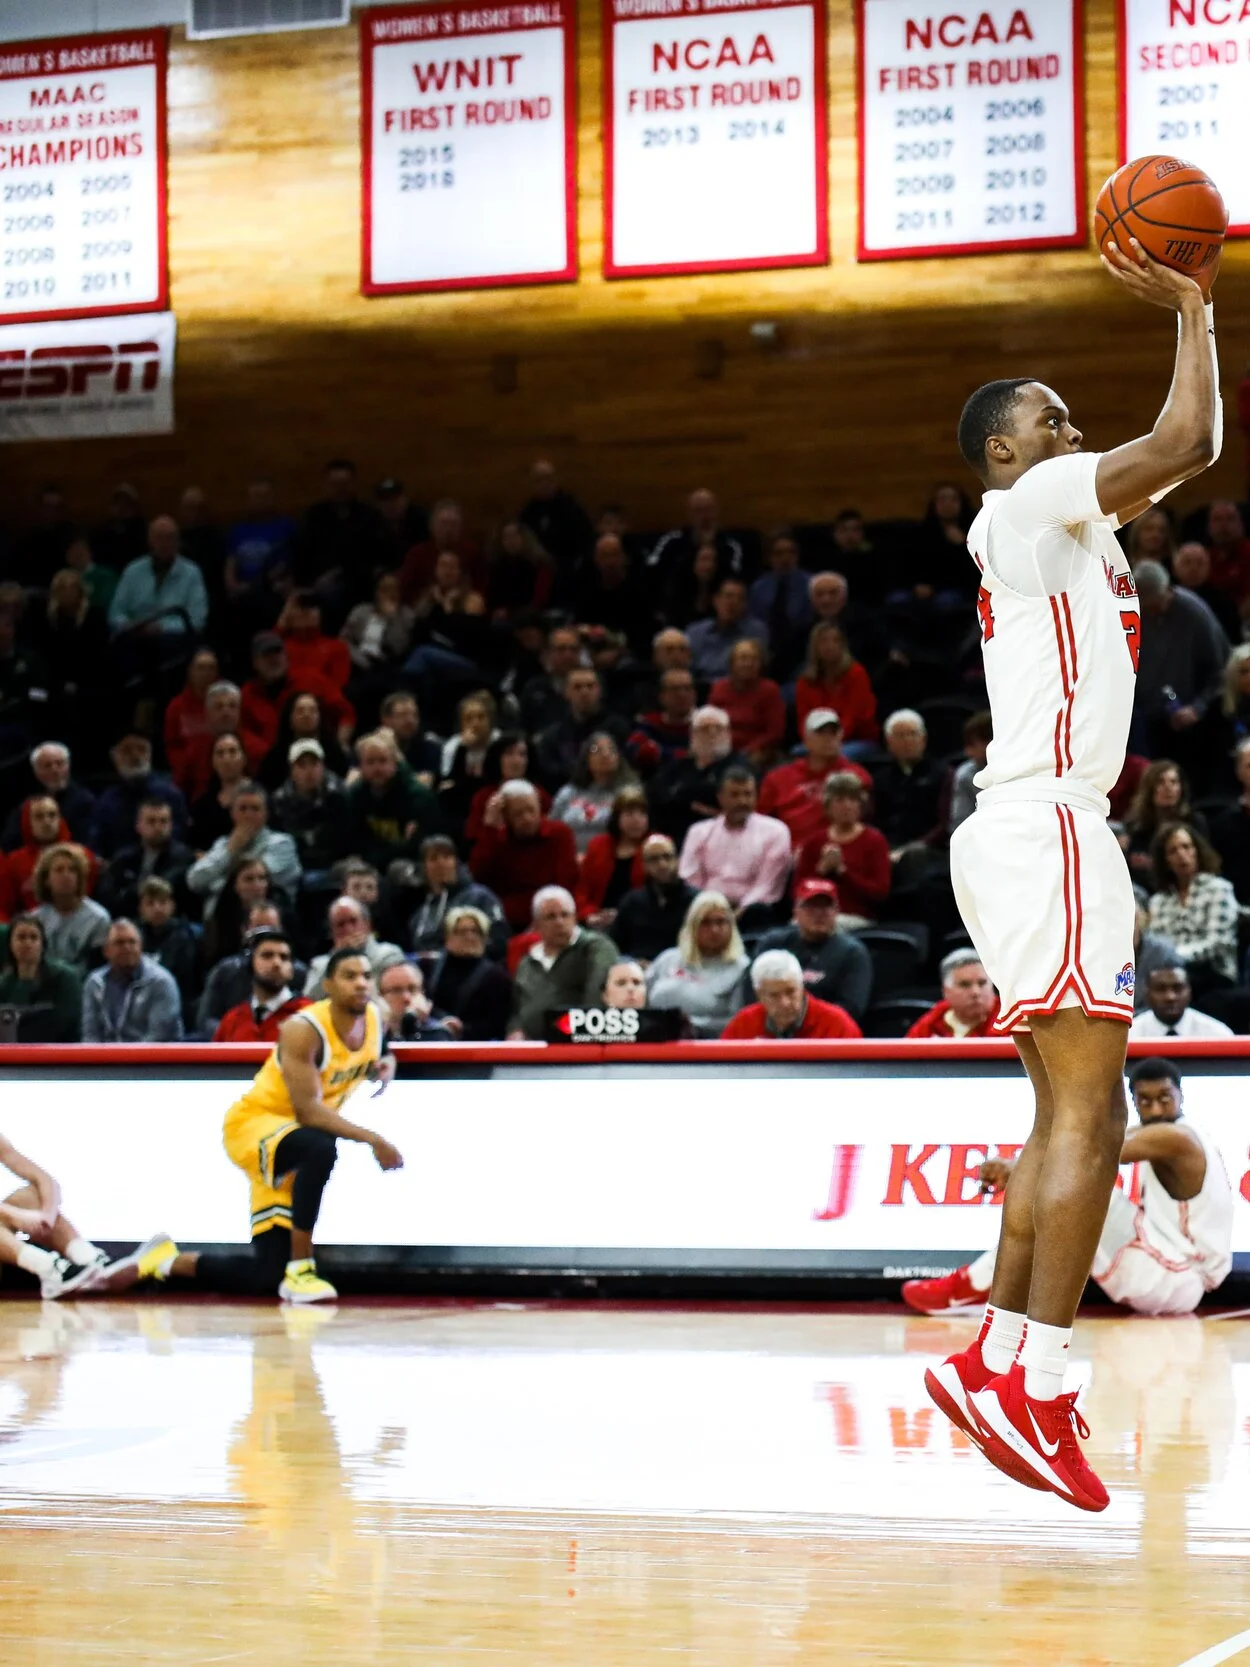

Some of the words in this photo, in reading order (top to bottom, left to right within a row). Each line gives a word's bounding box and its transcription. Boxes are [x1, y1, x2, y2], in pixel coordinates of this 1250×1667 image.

[905, 9, 1034, 51] NCAA
[653, 34, 774, 73] NCAA
[1140, 40, 1238, 72] SECOND
[412, 54, 523, 94] WNIT
[879, 64, 956, 93] FIRST
[968, 54, 1060, 86] ROUND
[30, 82, 107, 109] MAAC
[628, 85, 700, 113] FIRST
[711, 77, 802, 107] ROUND
[1158, 83, 1219, 107] 2007
[78, 107, 140, 128] SEASON
[384, 104, 455, 134] FIRST
[466, 96, 551, 126] ROUND
[896, 106, 954, 128] 2004
[1158, 119, 1219, 141] 2011
[4, 180, 55, 203] 2004
[986, 167, 1047, 190] 2010
[897, 210, 954, 231] 2011
[986, 203, 1046, 225] 2012
[1164, 239, 1202, 265] THE
[0, 341, 160, 399] ESPN
[568, 1008, 640, 1036] POSS
